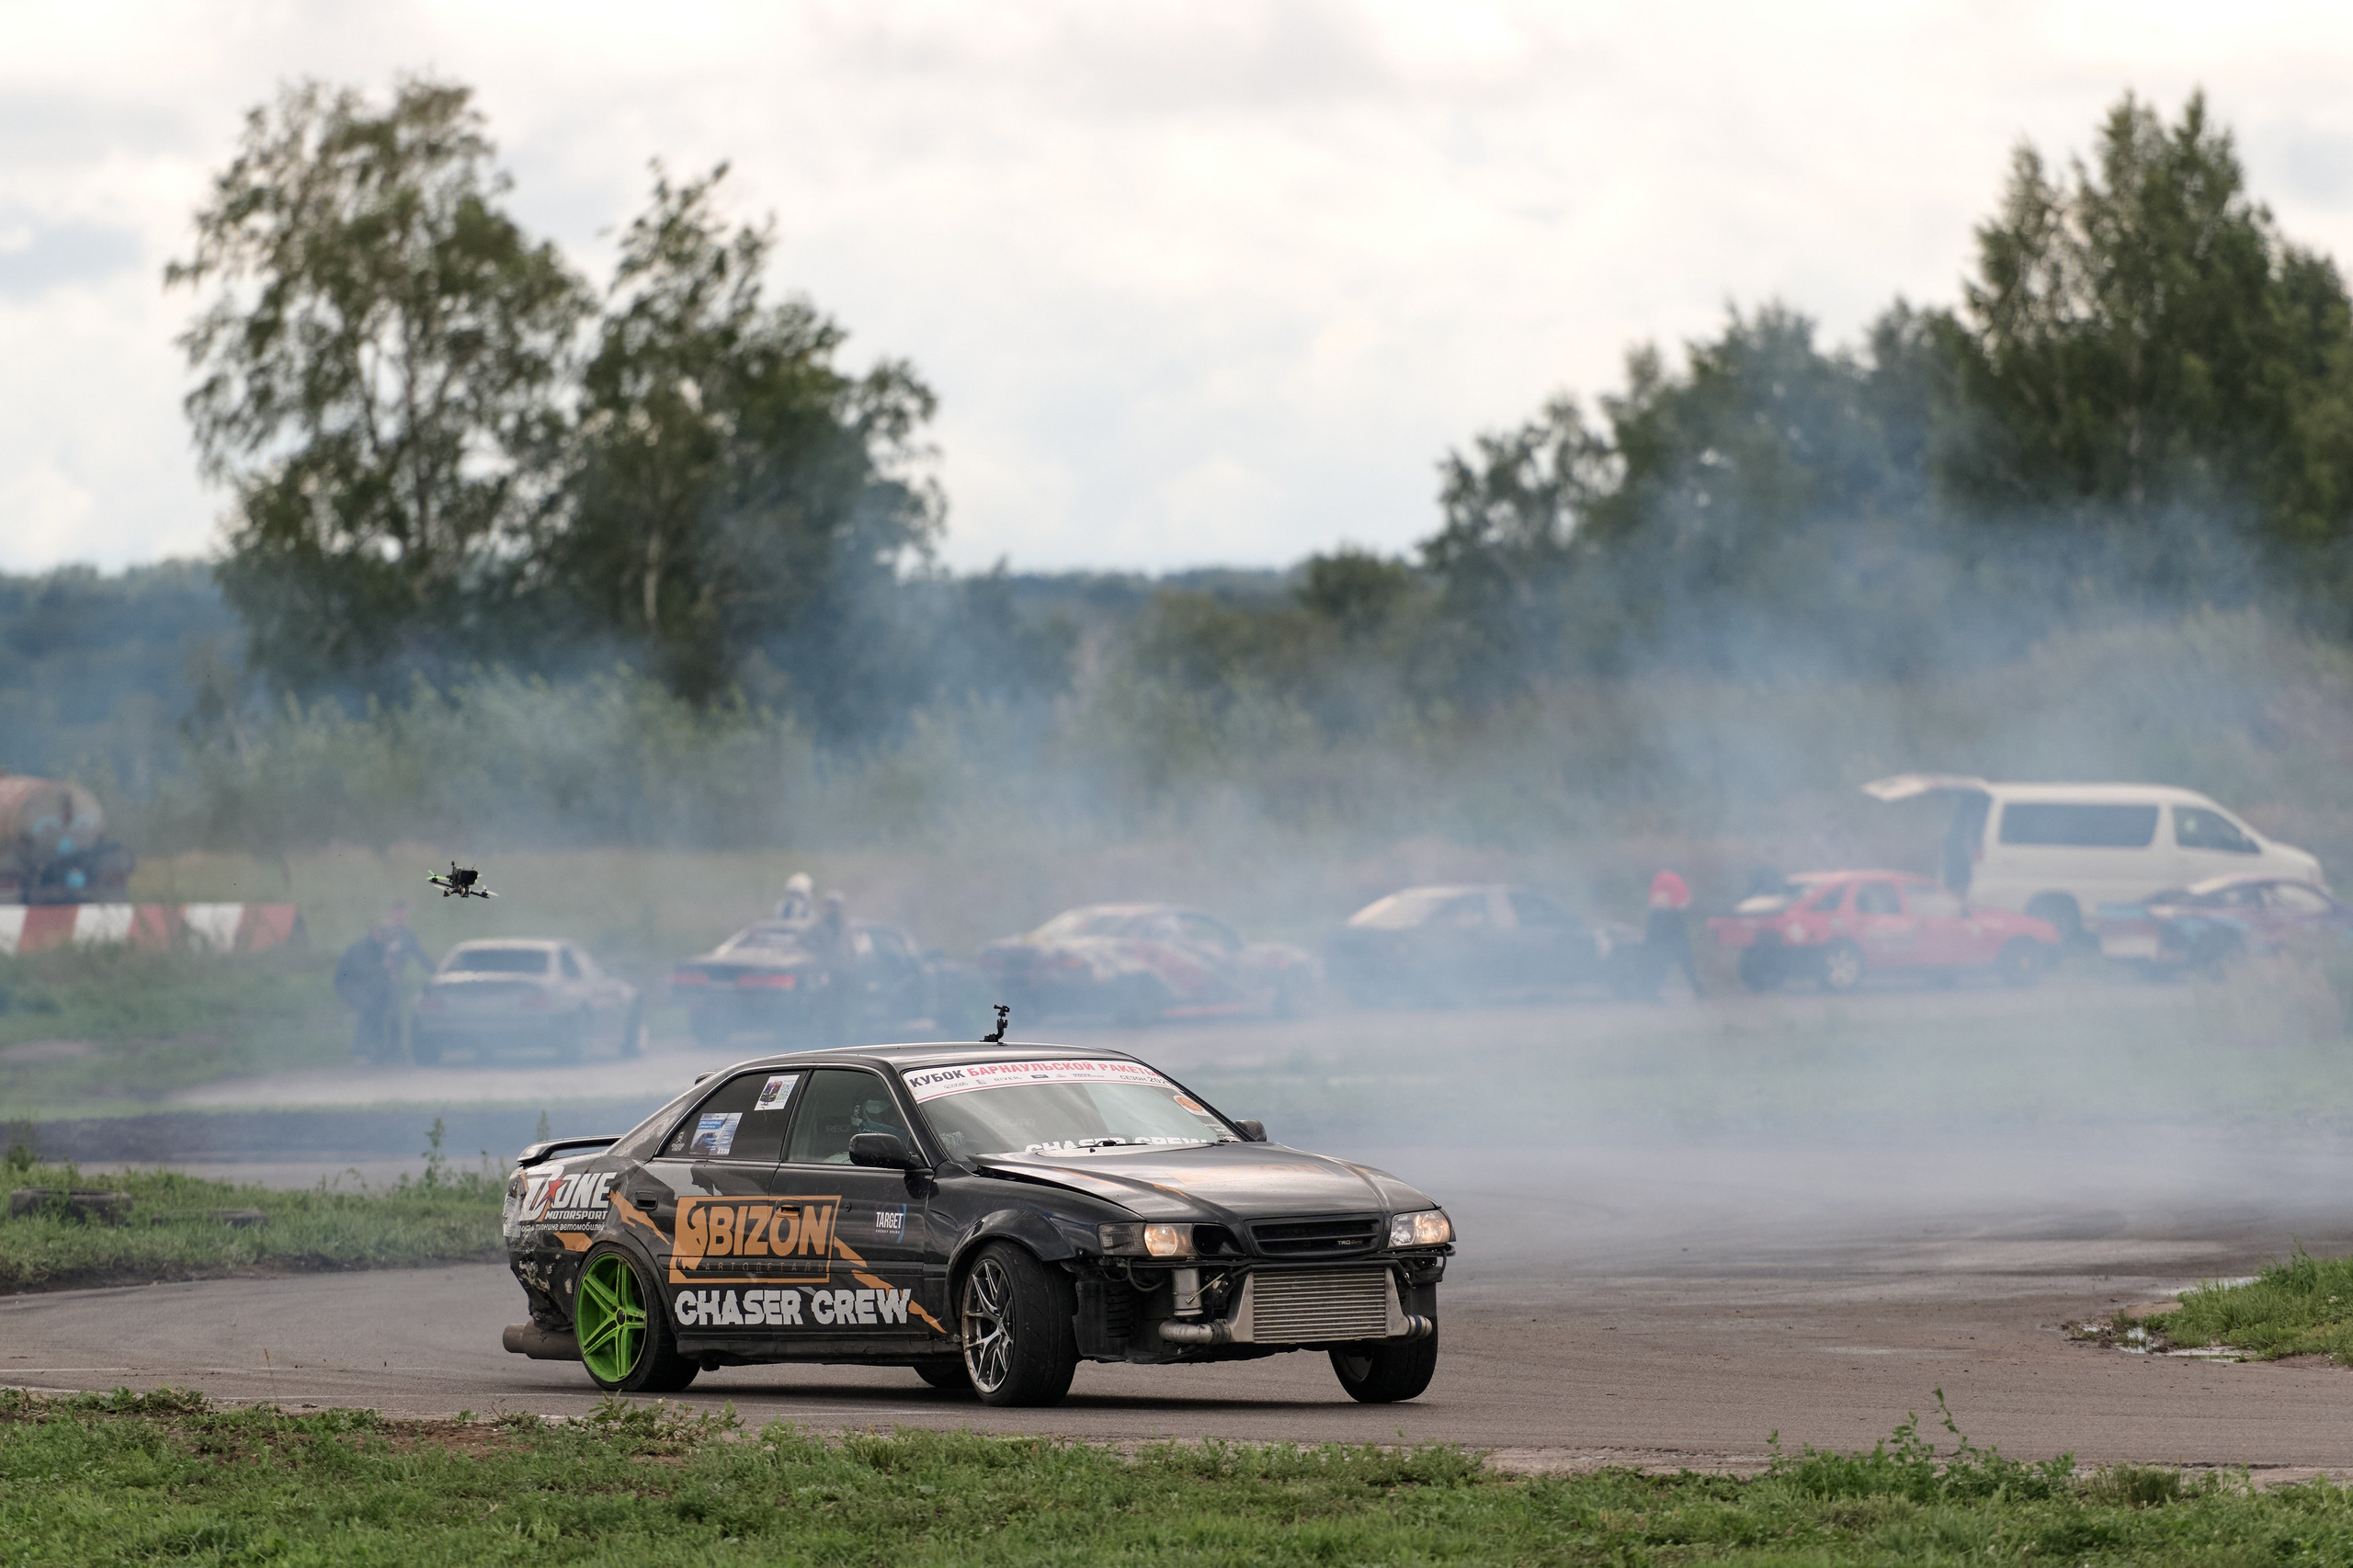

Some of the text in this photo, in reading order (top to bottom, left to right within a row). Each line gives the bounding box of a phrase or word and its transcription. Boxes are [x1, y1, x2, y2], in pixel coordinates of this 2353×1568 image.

[909, 1069, 966, 1088] КУБОК
[966, 1061, 1097, 1077] БАРНАУЛЬСКОЙ
[544, 1210, 608, 1221] MOTORSPORT
[559, 1221, 607, 1232] автомобилей
[876, 1211, 904, 1230] TARGET
[707, 1205, 832, 1256] BIZON
[674, 1288, 912, 1326] CHASER CREW
